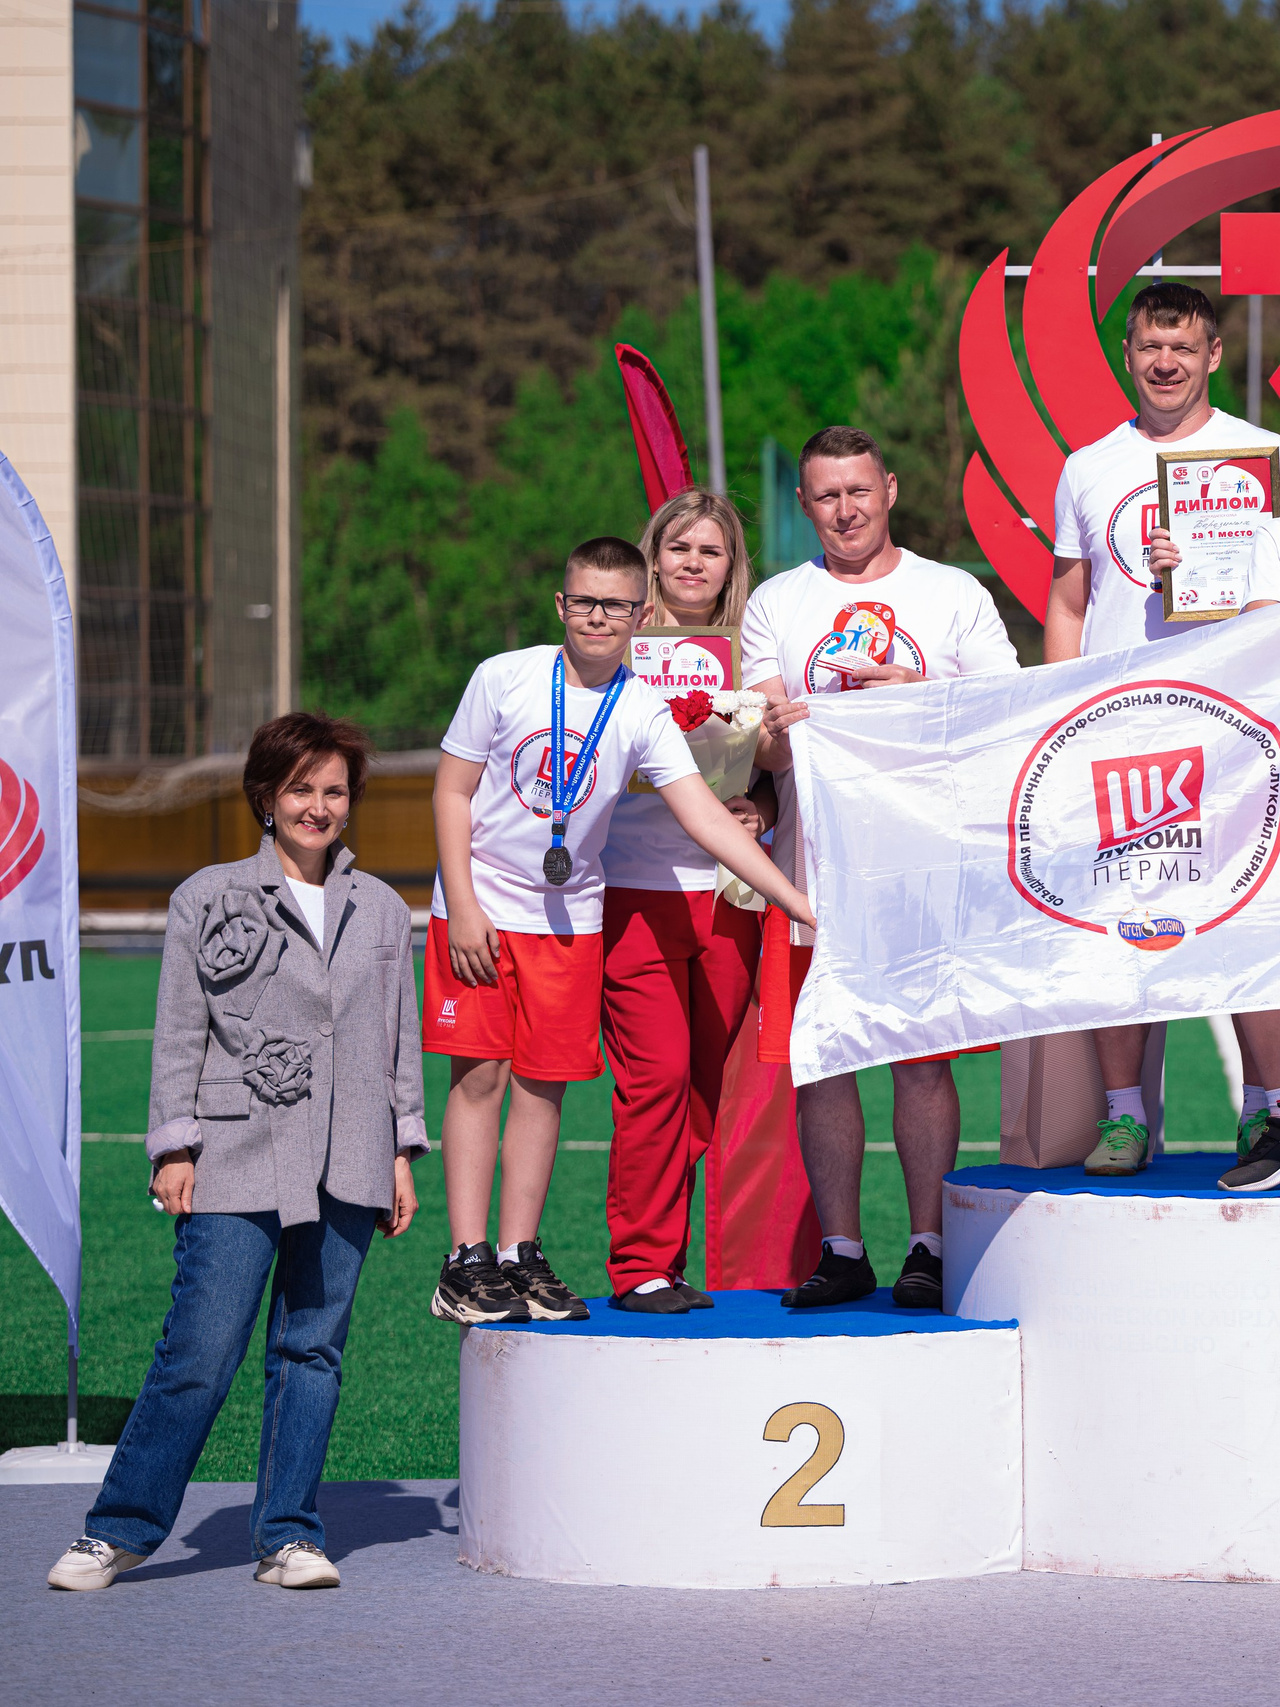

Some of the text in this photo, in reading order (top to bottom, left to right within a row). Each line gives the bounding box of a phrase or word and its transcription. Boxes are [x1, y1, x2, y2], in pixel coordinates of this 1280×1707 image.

[1174, 497, 1259, 514] ДИПЛОМ
[1192, 529, 1253, 540] за 1 место
[1019, 693, 1280, 906] ОБЪЕДИНЕННАЯ ПЕРВИЧНАЯ ПРОФСОЮЗНАЯ ОРГАНИЗАЦИЯ ООО «ЛУКОЙЛ-ПЕРМЬ»
[1093, 824, 1202, 862] ЛУКОЙЛ
[1093, 859, 1202, 886] ПЕРМЬ
[1120, 923, 1142, 938] НГСП
[1156, 919, 1184, 934] ROGWU
[760, 1401, 846, 1528] 2
